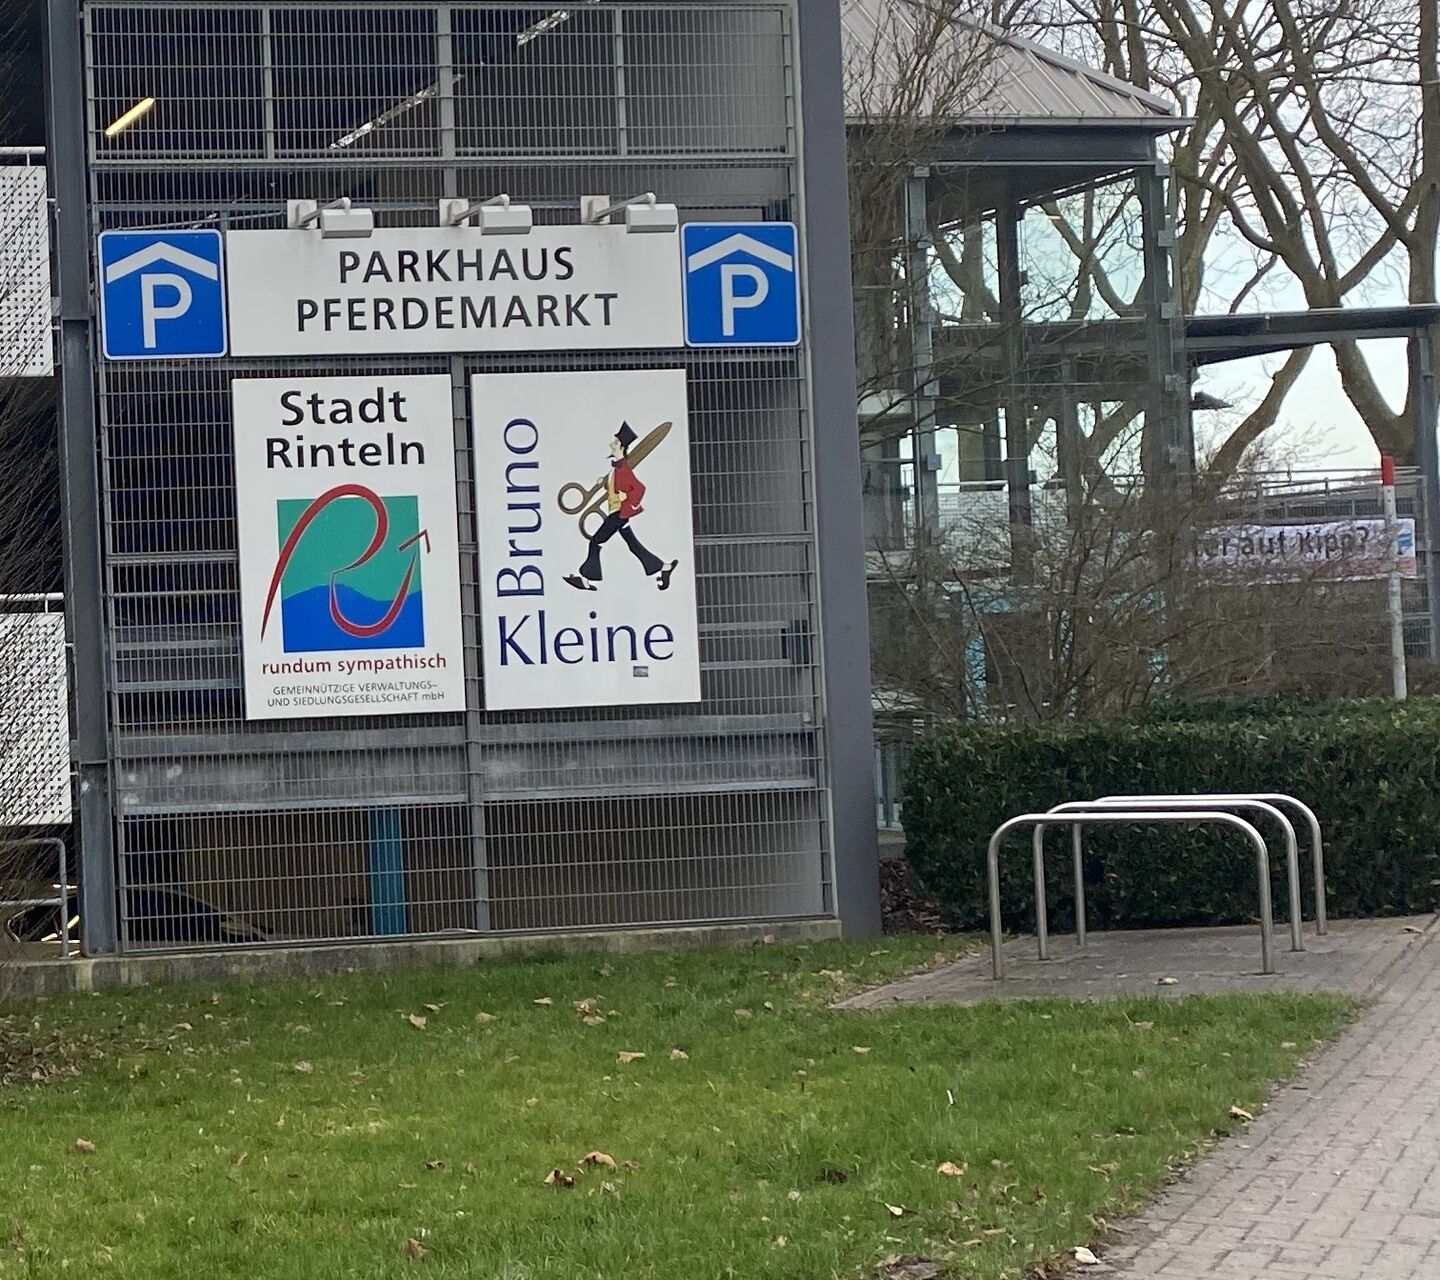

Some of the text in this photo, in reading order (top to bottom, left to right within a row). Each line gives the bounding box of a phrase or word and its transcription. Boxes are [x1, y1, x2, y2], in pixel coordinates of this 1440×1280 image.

[339, 246, 575, 284] PARKHAUS
[140, 272, 193, 349] P
[297, 293, 619, 332] PFERDEMARKT
[720, 263, 770, 337] P
[280, 386, 408, 426] Stadt
[266, 432, 425, 469] Rinteln
[496, 417, 545, 598] Bruno
[498, 609, 675, 666] Kleine
[262, 653, 447, 676] rundum sympathisch
[267, 691, 446, 708] UND SIEDLUNGSGESELLSCHAFT mbH
[272, 681, 356, 696] GEMEINNÜTZIGE
